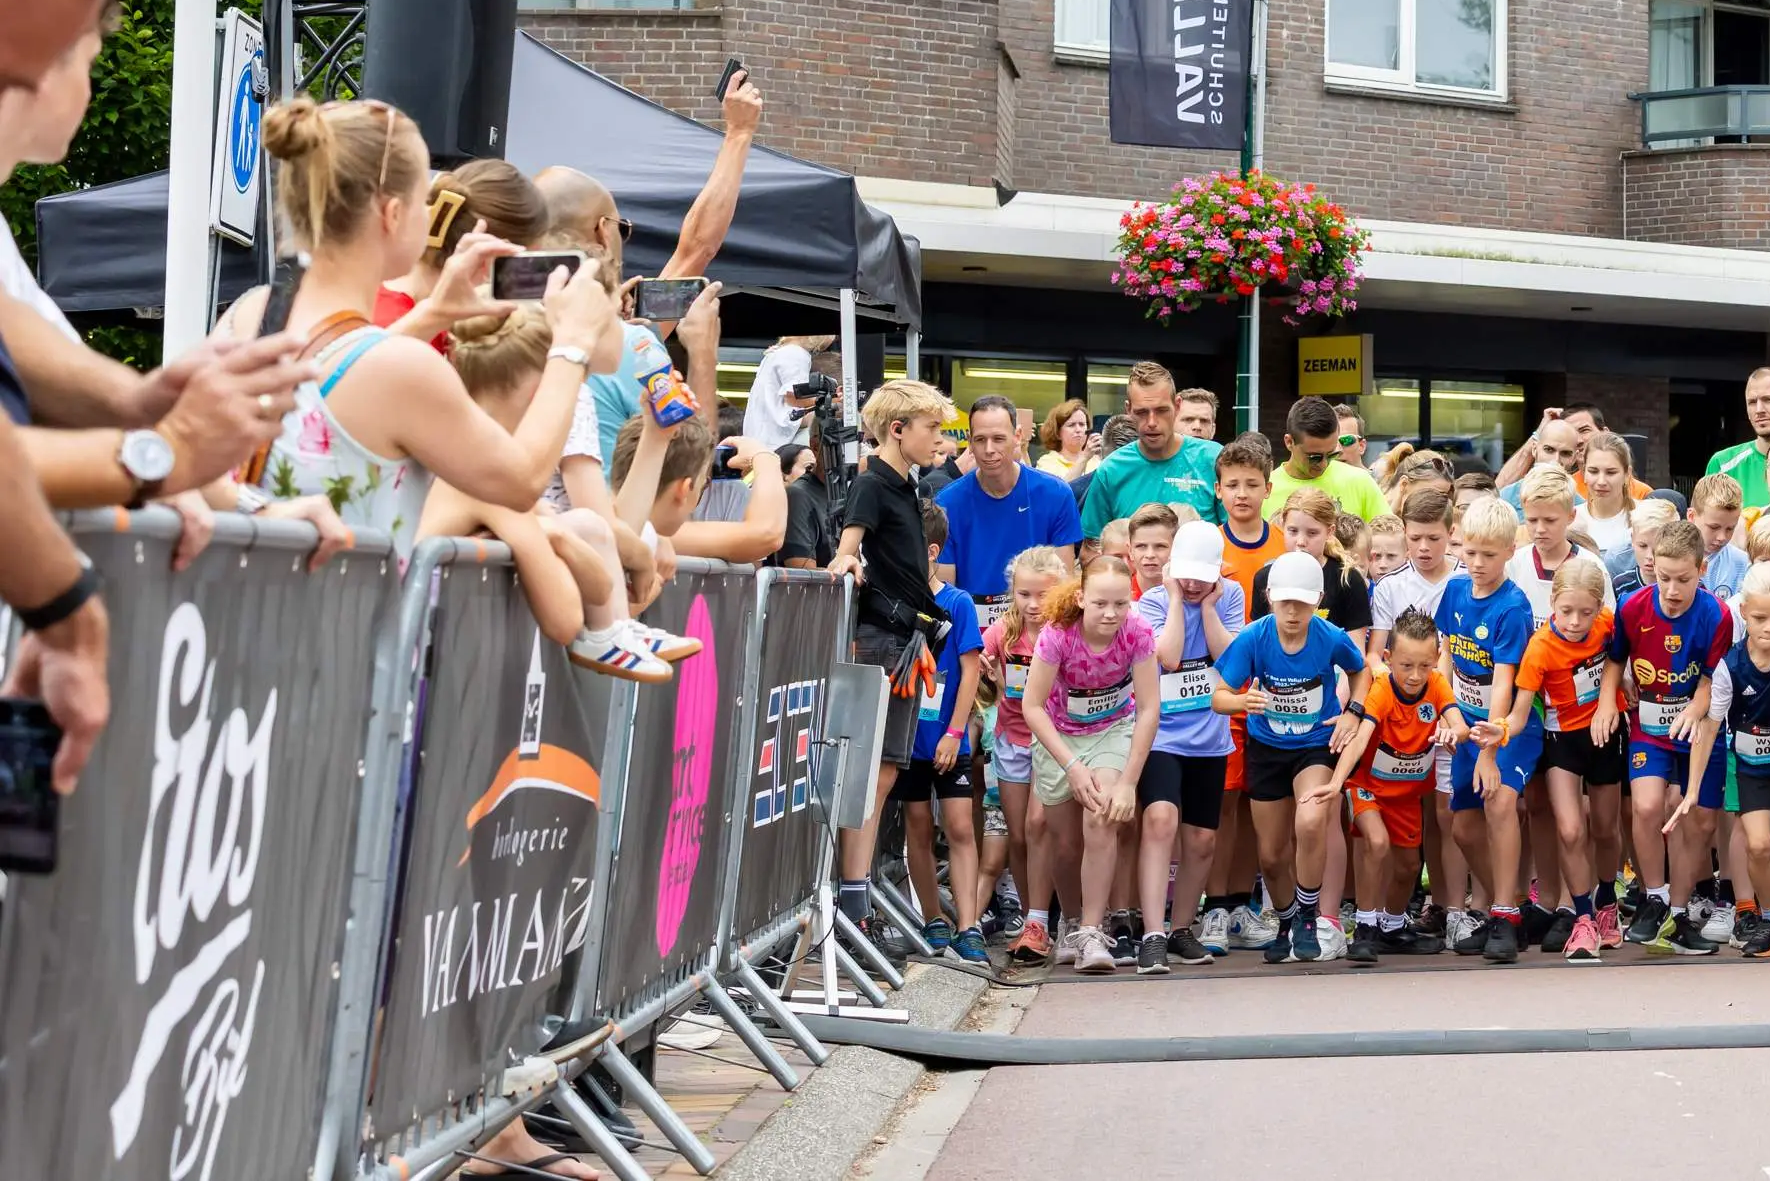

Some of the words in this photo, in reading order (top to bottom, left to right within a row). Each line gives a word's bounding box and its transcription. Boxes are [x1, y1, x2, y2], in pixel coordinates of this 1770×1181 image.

[1303, 357, 1358, 372] ZEEMAN
[1183, 674, 1206, 684] Elise
[1180, 682, 1211, 698] 0126
[1088, 693, 1120, 706] Emilie
[1272, 695, 1308, 704] Anissa
[1460, 691, 1483, 708] 0139
[1087, 700, 1118, 714] 0017
[1274, 704, 1308, 714] 0036
[1391, 766, 1424, 774] 0066
